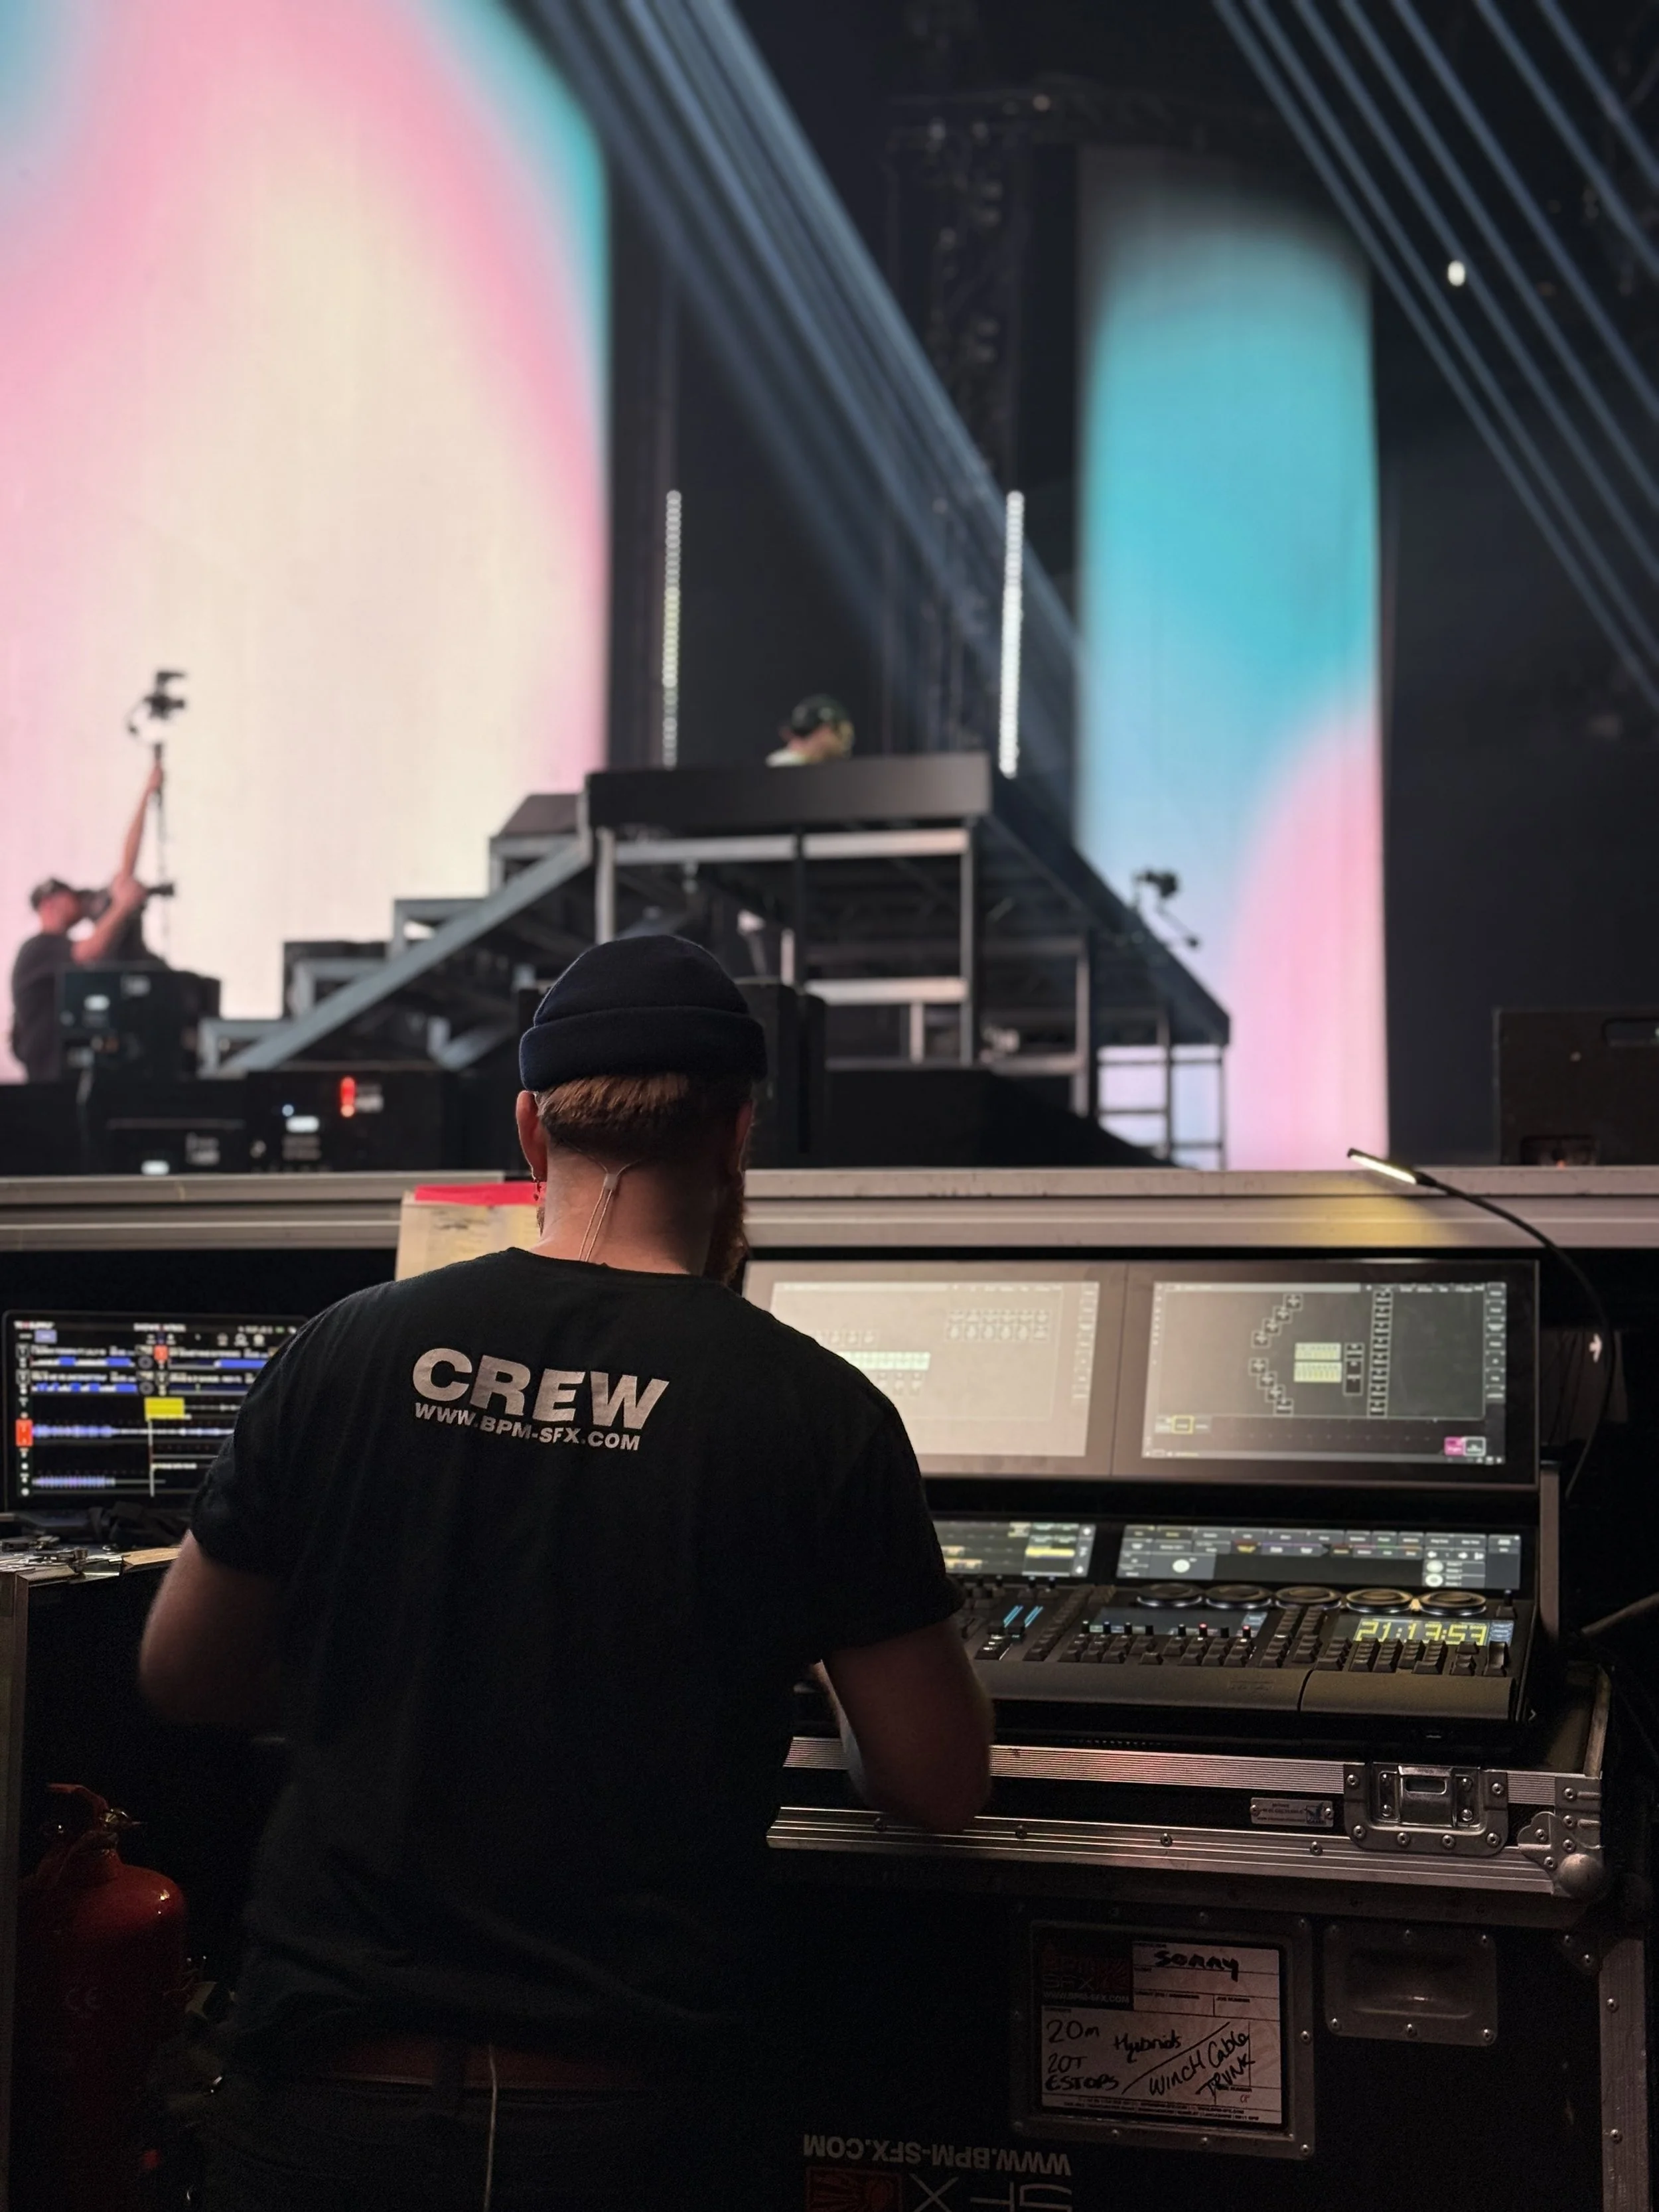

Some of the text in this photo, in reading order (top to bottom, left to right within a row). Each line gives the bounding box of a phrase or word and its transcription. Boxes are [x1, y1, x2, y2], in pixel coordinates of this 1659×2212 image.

[413, 1348, 669, 1430] CREW
[415, 1402, 641, 1451] WWW.BPM-SFX.COM
[803, 2134, 1072, 2176] WWW.BPM-SFX.COM
